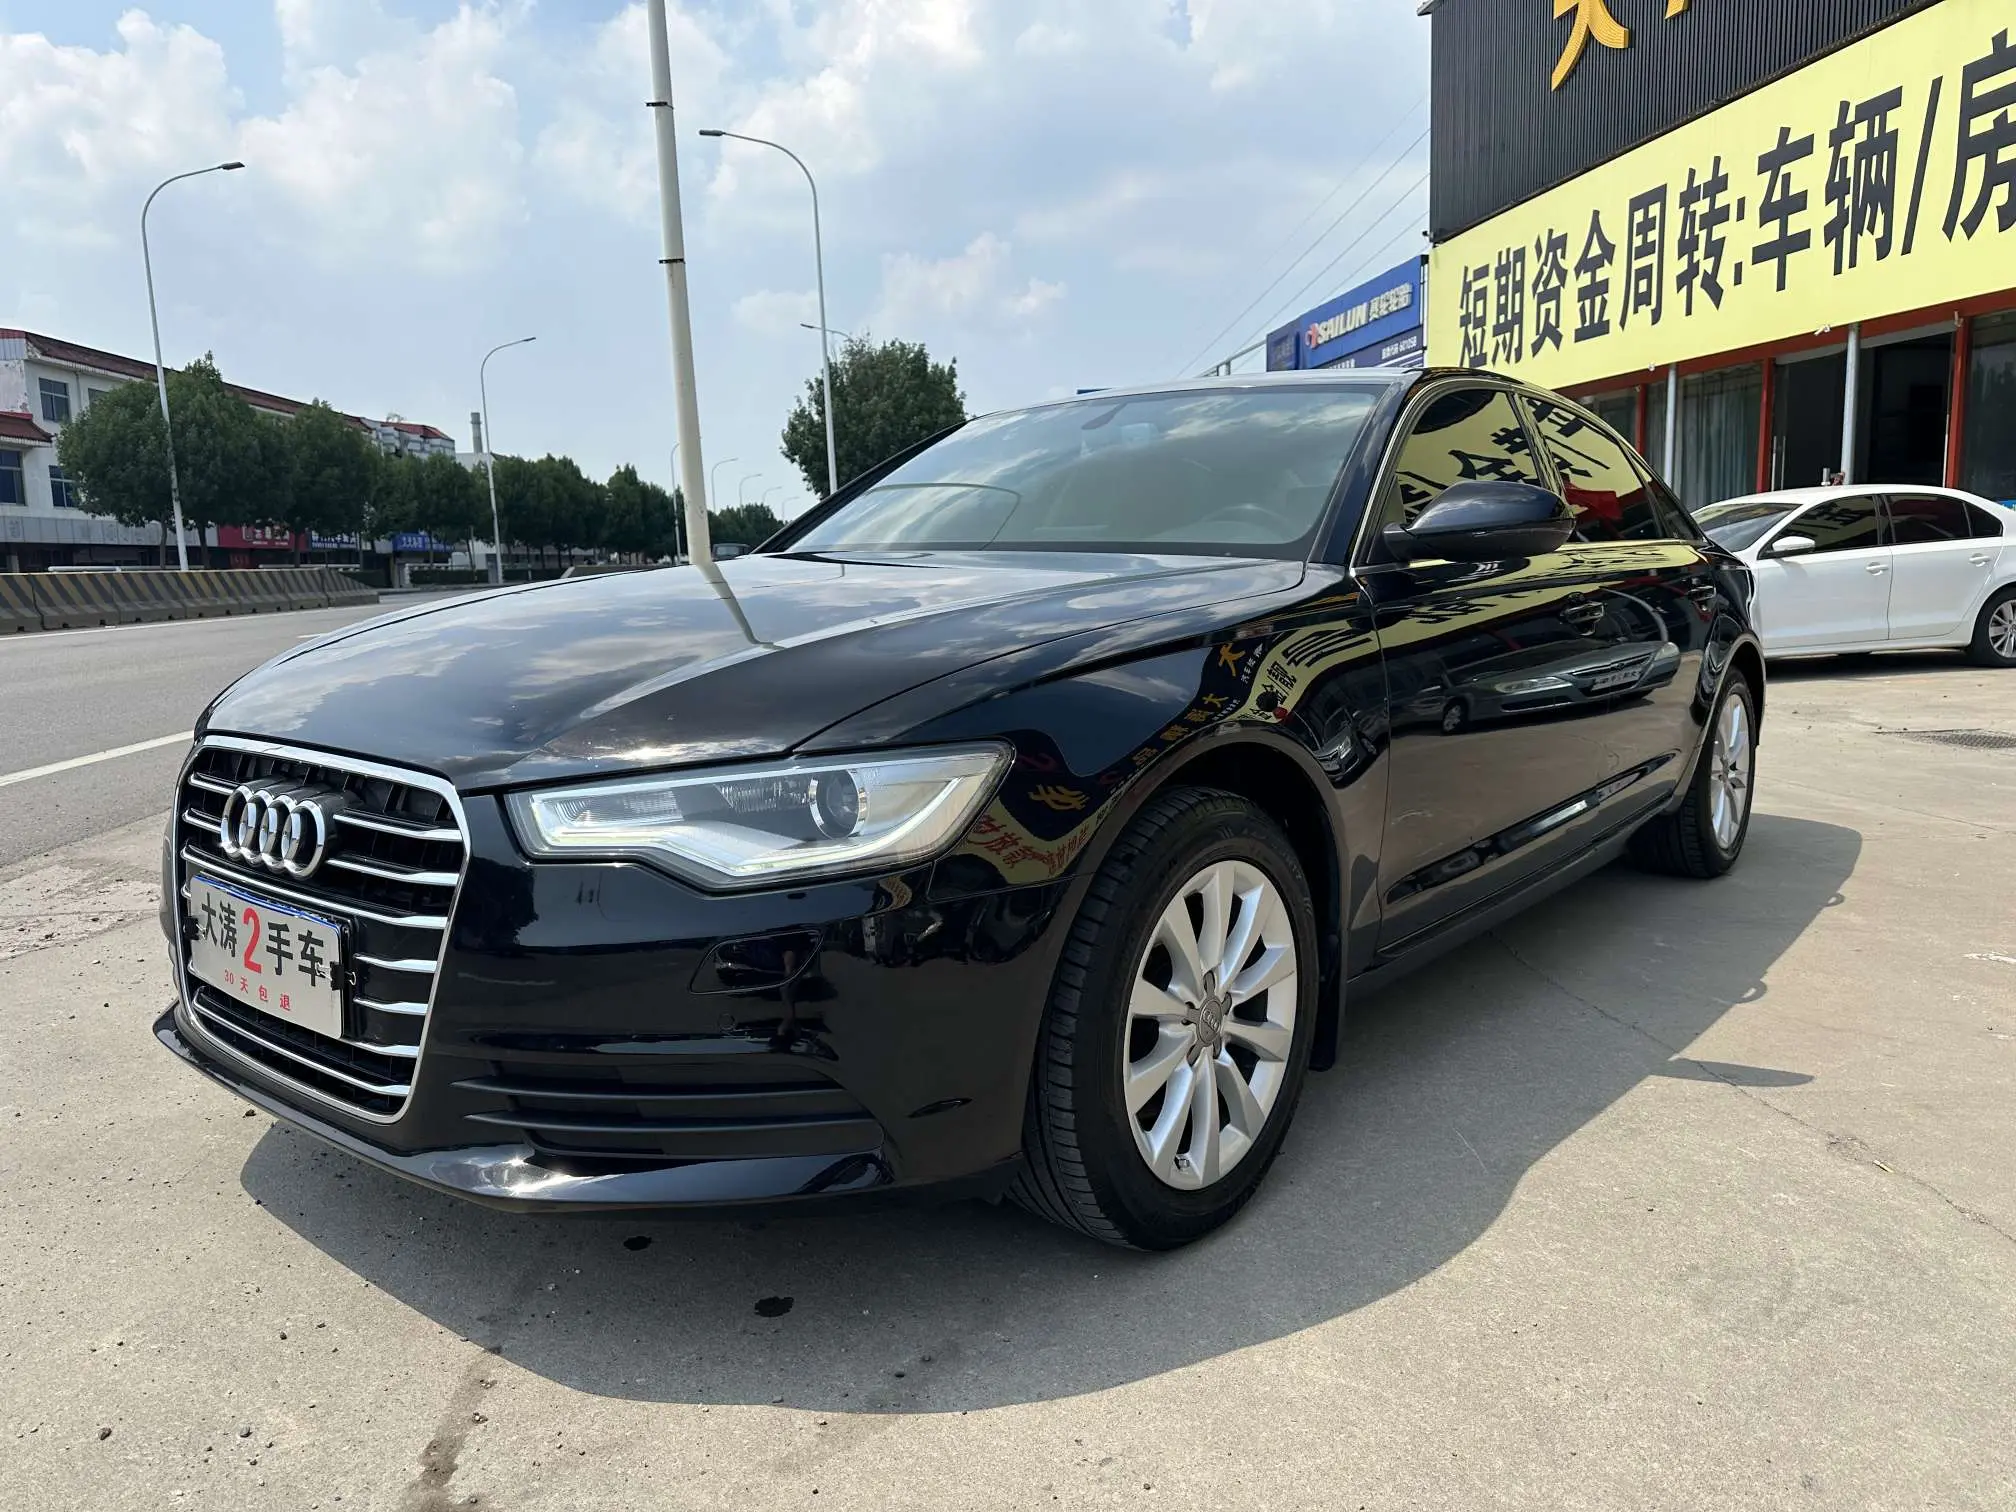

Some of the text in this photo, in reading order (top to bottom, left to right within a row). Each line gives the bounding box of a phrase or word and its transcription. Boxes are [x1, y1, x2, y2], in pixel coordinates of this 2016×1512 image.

[1317, 301, 1368, 345] SAILUN
[201, 892, 324, 987] 大涛2手车
[224, 969, 292, 1012] 30天包退
